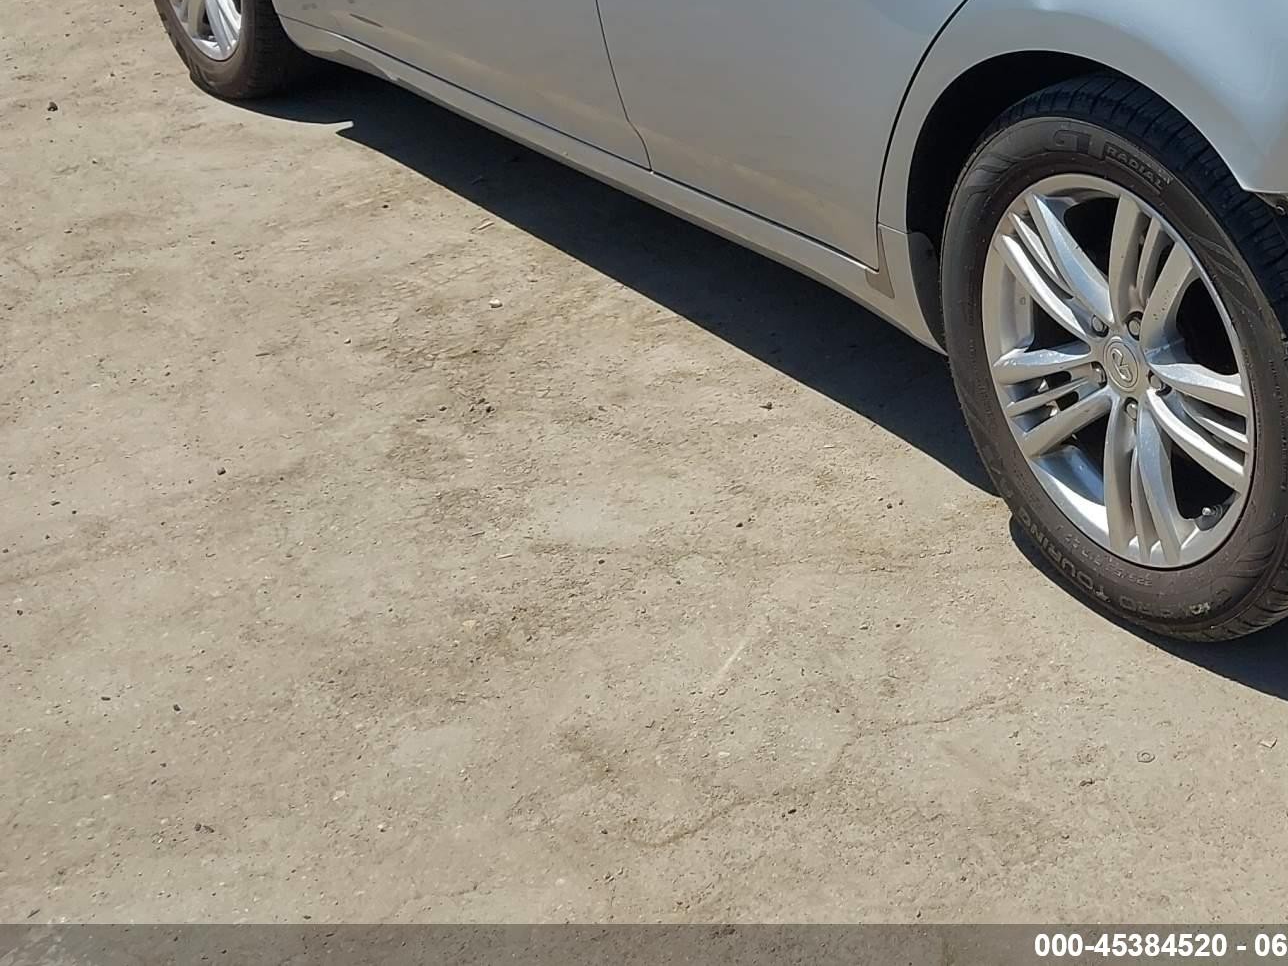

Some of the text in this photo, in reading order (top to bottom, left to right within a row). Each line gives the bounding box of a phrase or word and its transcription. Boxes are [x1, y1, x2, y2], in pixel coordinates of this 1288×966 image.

[1052, 129, 1166, 191] GT RADIAL
[1017, 506, 1111, 603] TOURING
